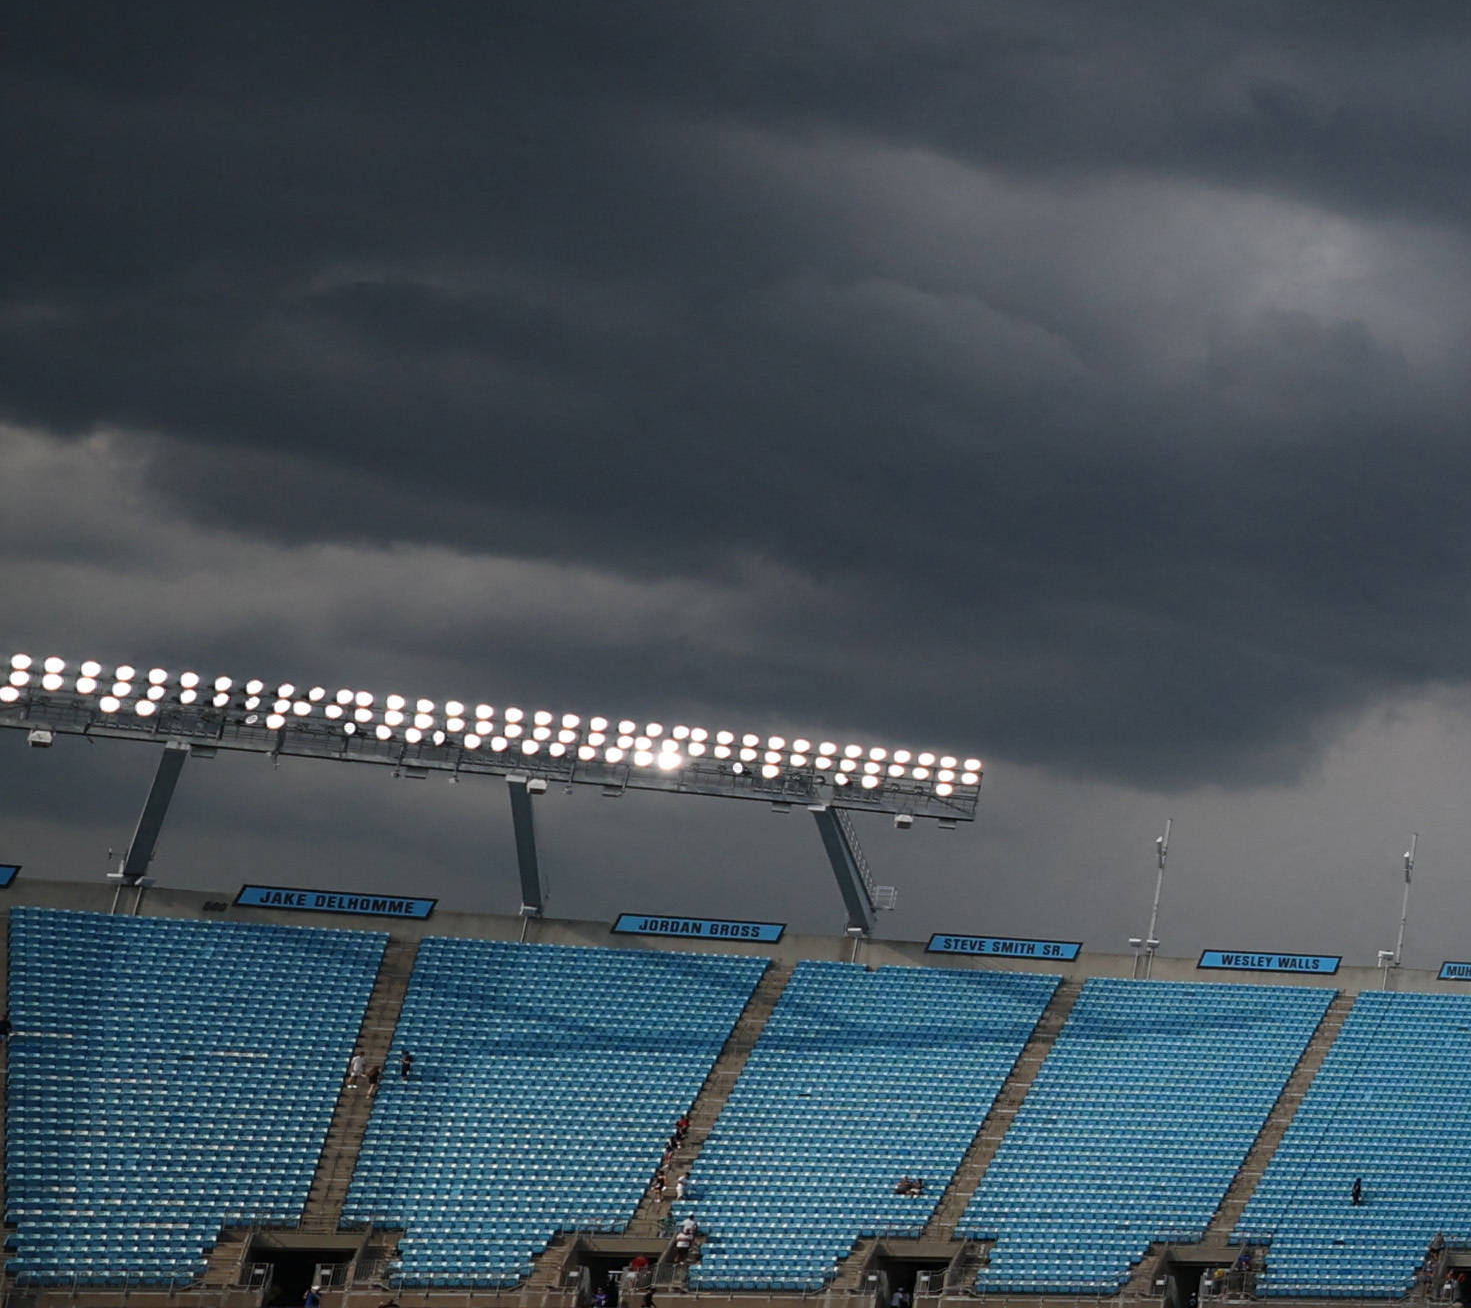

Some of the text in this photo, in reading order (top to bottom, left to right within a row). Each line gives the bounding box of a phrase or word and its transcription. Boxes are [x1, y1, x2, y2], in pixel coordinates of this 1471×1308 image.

[259, 890, 415, 914] JAKE DELHOMME
[637, 917, 761, 938] JORDAN GROSS
[943, 937, 987, 954] STEVE
[991, 940, 1036, 957] SMITH
[1220, 952, 1321, 971] WESLEY WALLS
